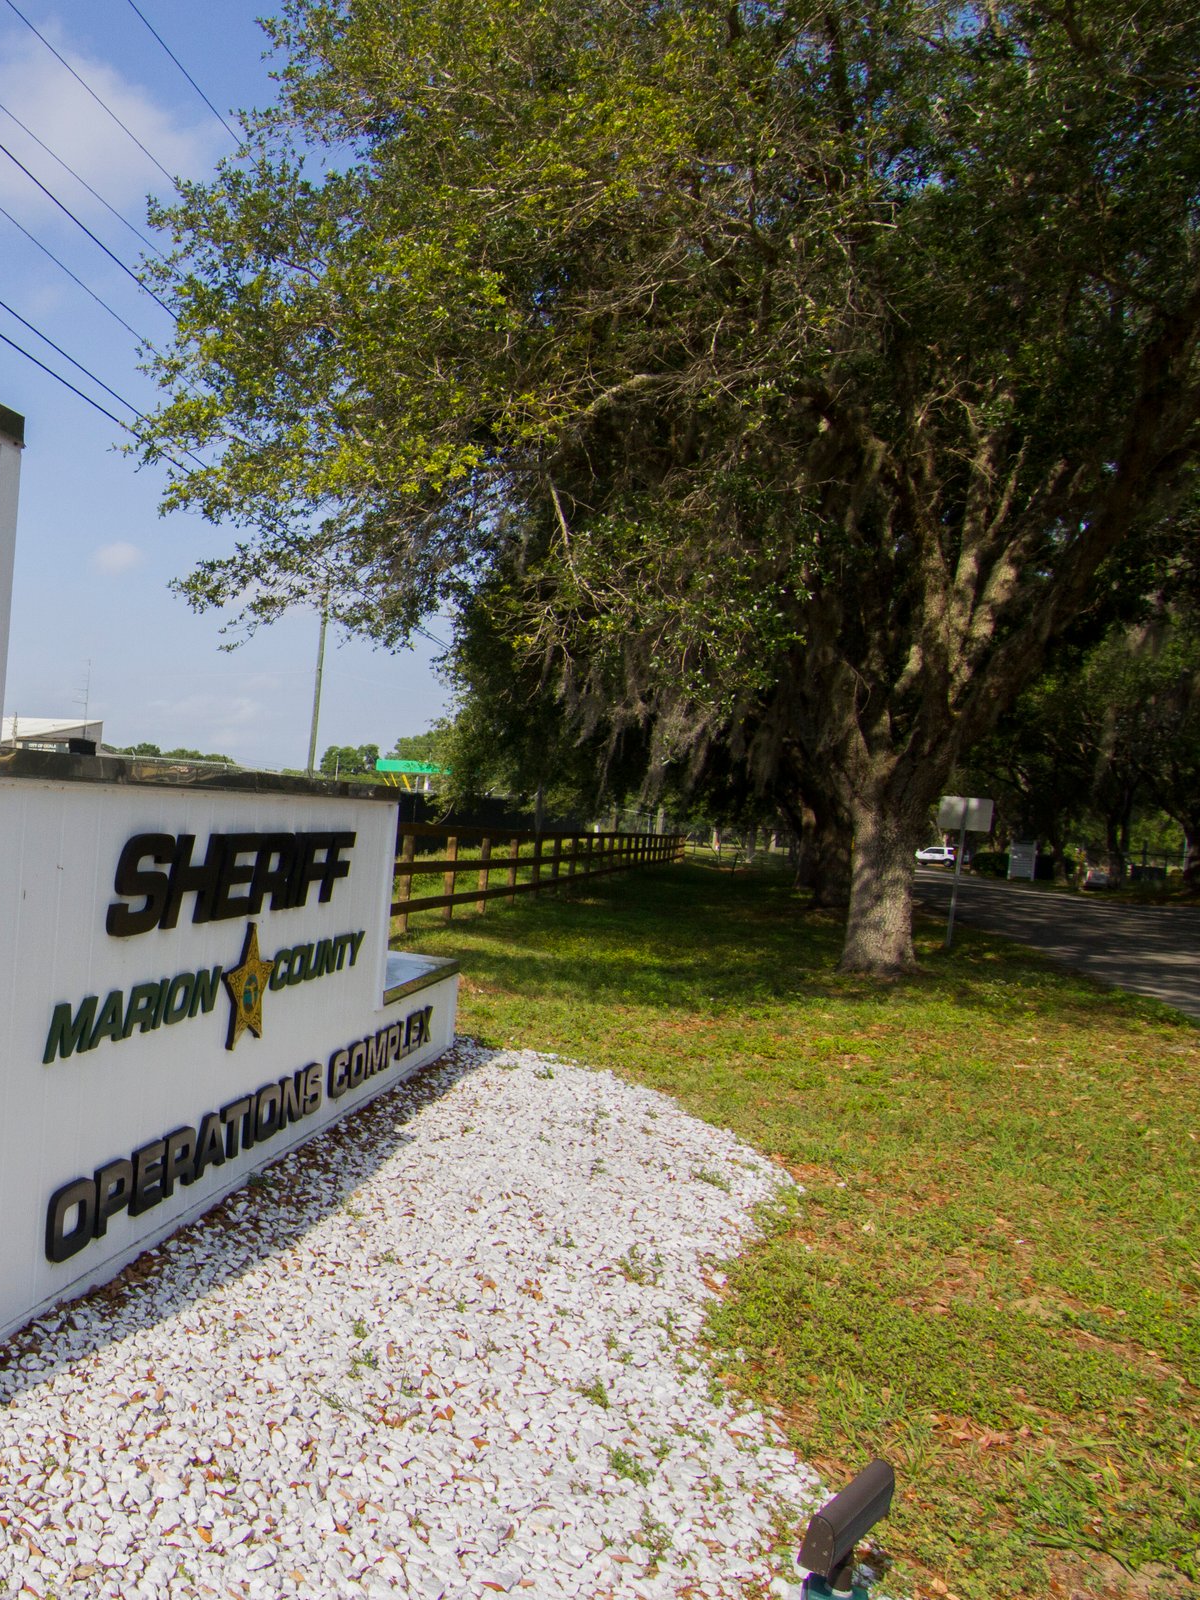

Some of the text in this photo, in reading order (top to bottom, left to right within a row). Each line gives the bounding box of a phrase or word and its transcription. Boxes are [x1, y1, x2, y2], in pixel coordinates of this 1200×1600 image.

[106, 831, 356, 937] SHERIFF
[42, 930, 366, 1064] MARION COUNTY
[45, 1005, 434, 1264] OPERATIONS COMPLEX
